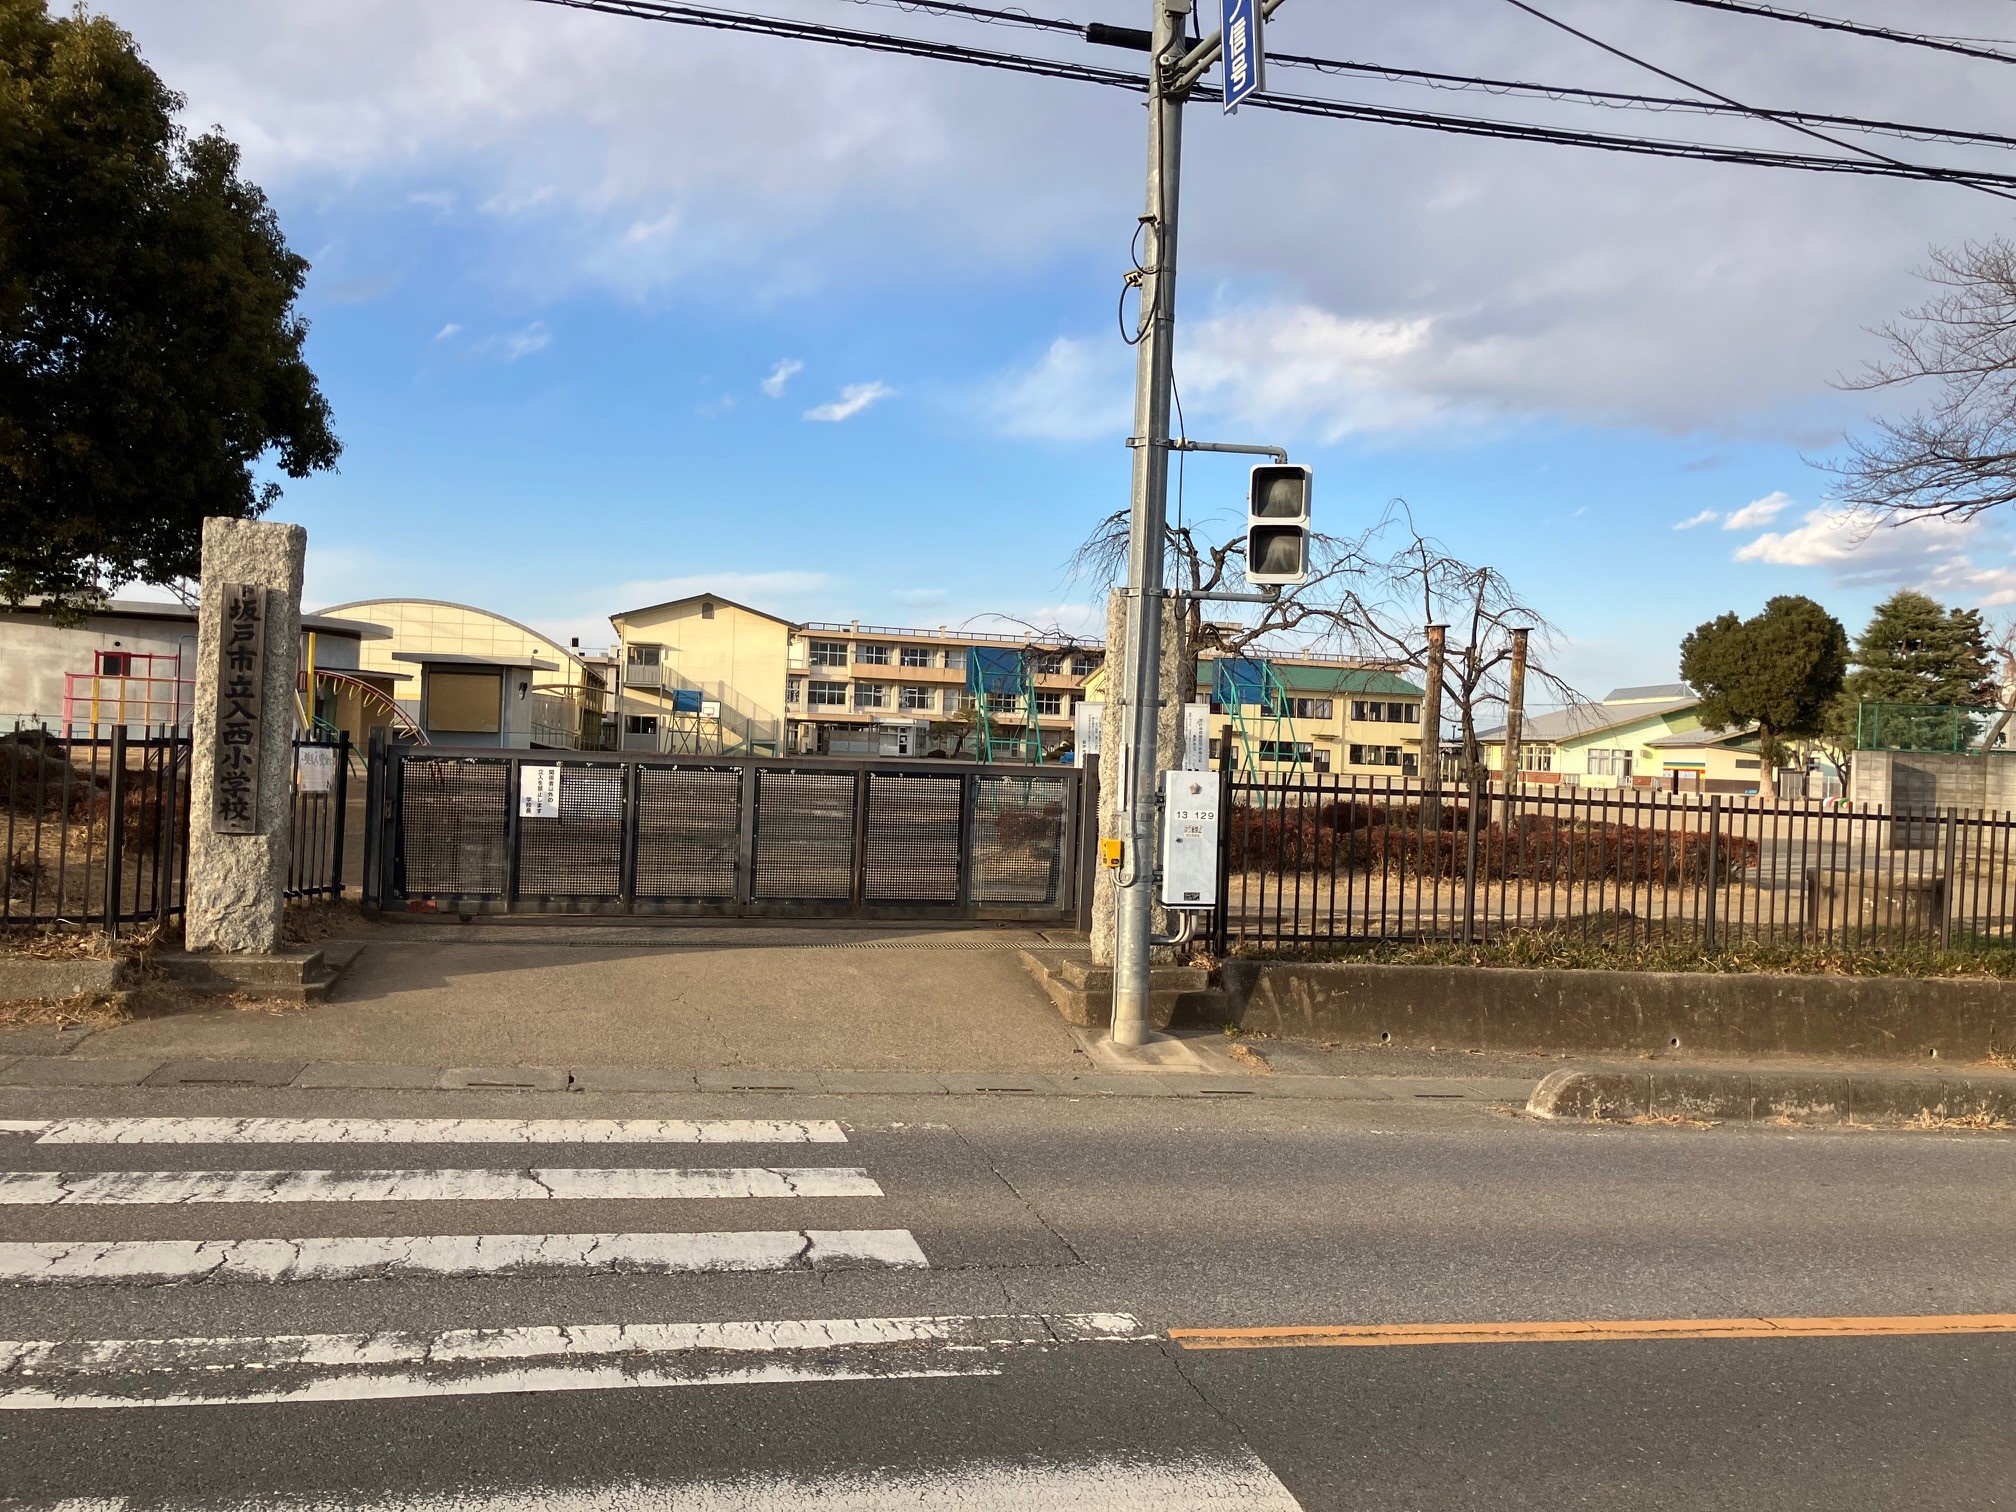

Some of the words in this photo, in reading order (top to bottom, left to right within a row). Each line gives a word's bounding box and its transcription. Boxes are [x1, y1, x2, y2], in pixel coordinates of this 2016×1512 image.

[217, 598, 261, 821] 坂戸市立入西小学校
[1177, 810, 1188, 819] 13
[1194, 811, 1214, 820] 129
